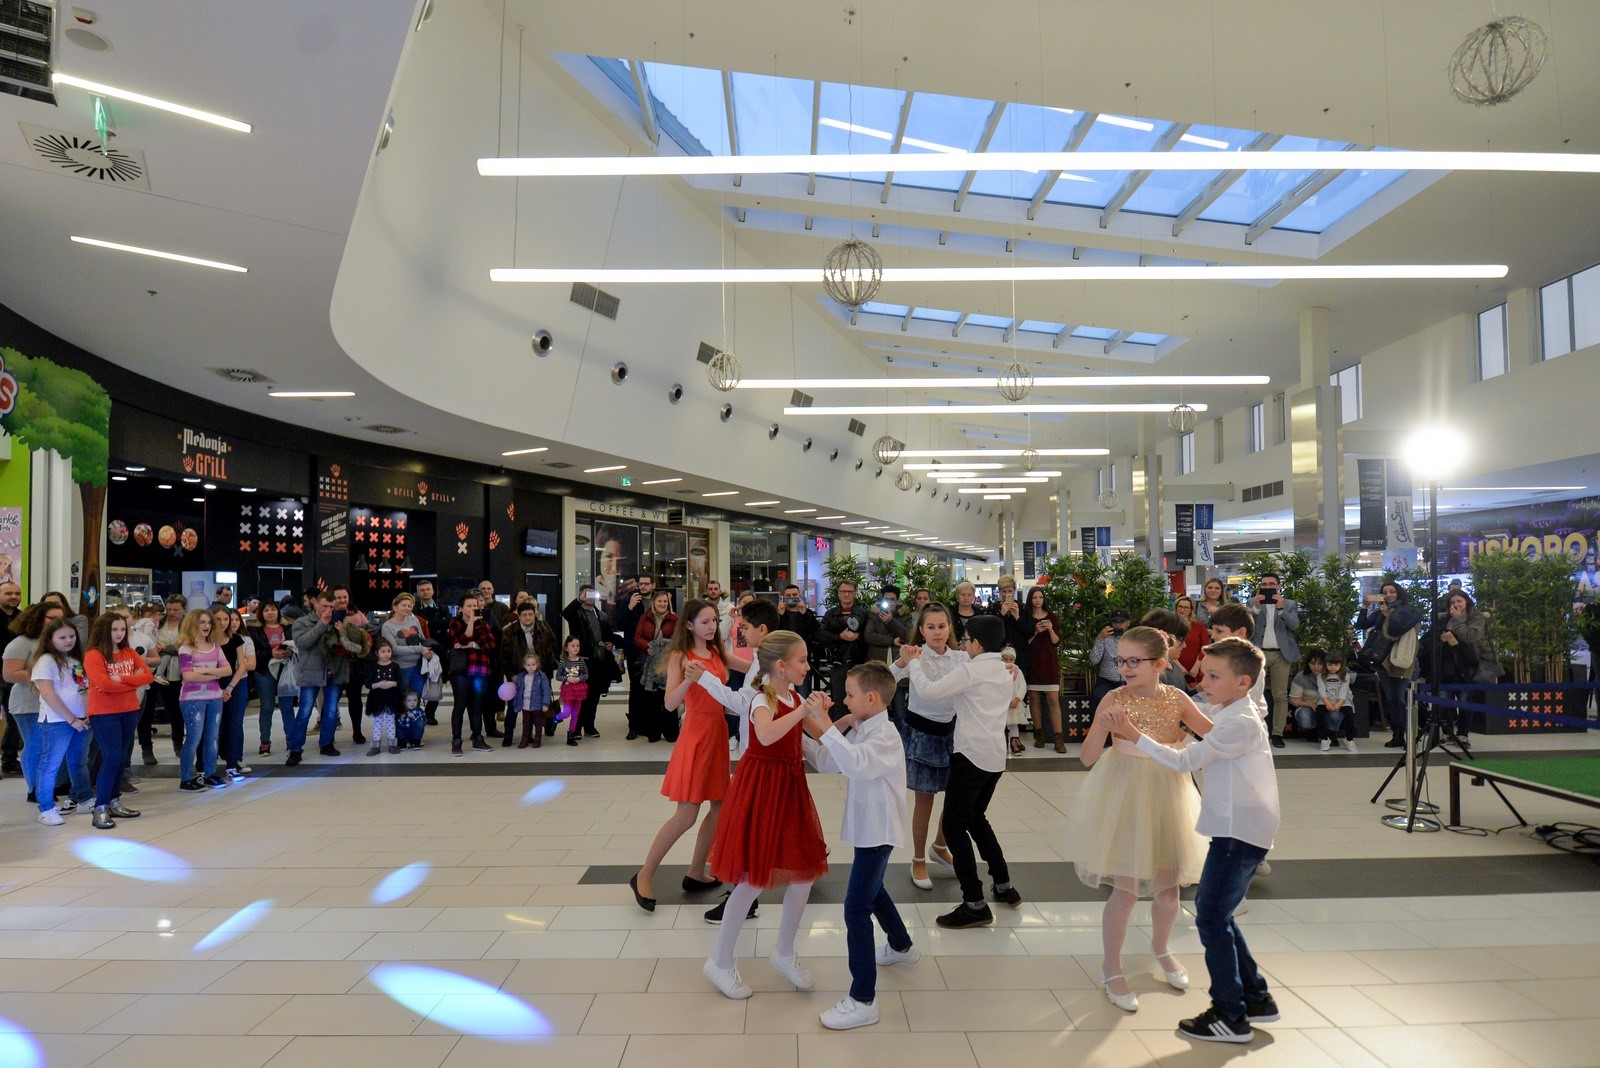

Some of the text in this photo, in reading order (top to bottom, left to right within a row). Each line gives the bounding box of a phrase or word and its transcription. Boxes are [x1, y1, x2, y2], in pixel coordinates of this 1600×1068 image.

[182, 428, 227, 455] Medonja
[590, 502, 634, 517] COFFEE
[684, 516, 701, 526] BAR
